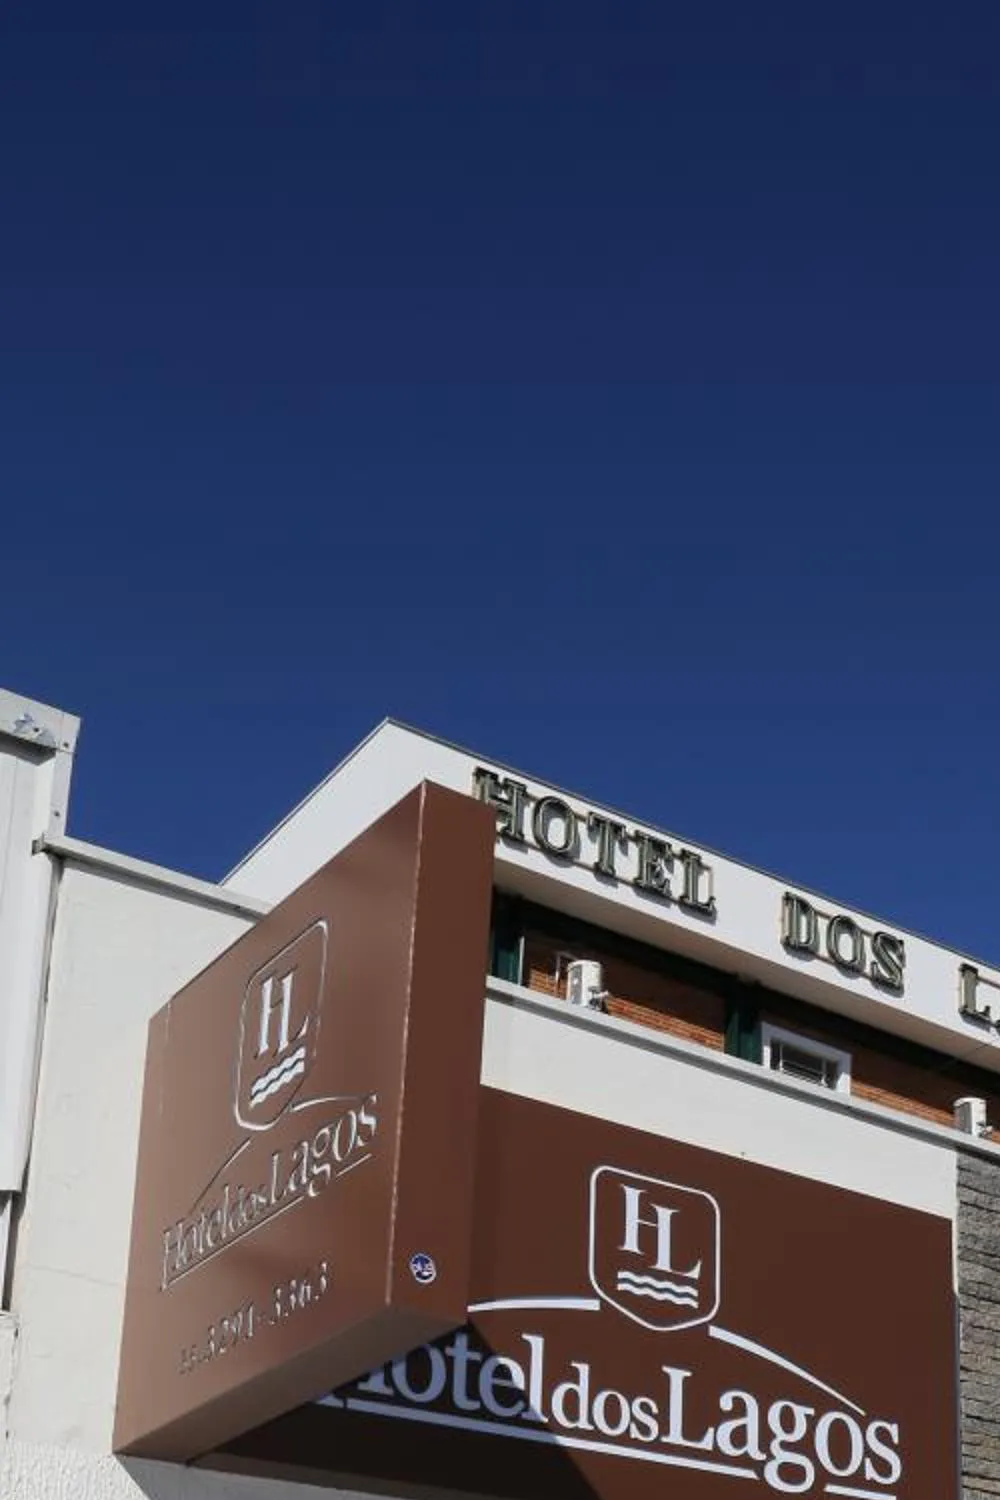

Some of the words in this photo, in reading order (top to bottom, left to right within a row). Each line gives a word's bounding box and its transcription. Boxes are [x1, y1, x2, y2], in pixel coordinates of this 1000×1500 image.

[471, 766, 717, 918] HOTEL
[780, 892, 906, 991] DOS
[617, 1184, 701, 1278] HL
